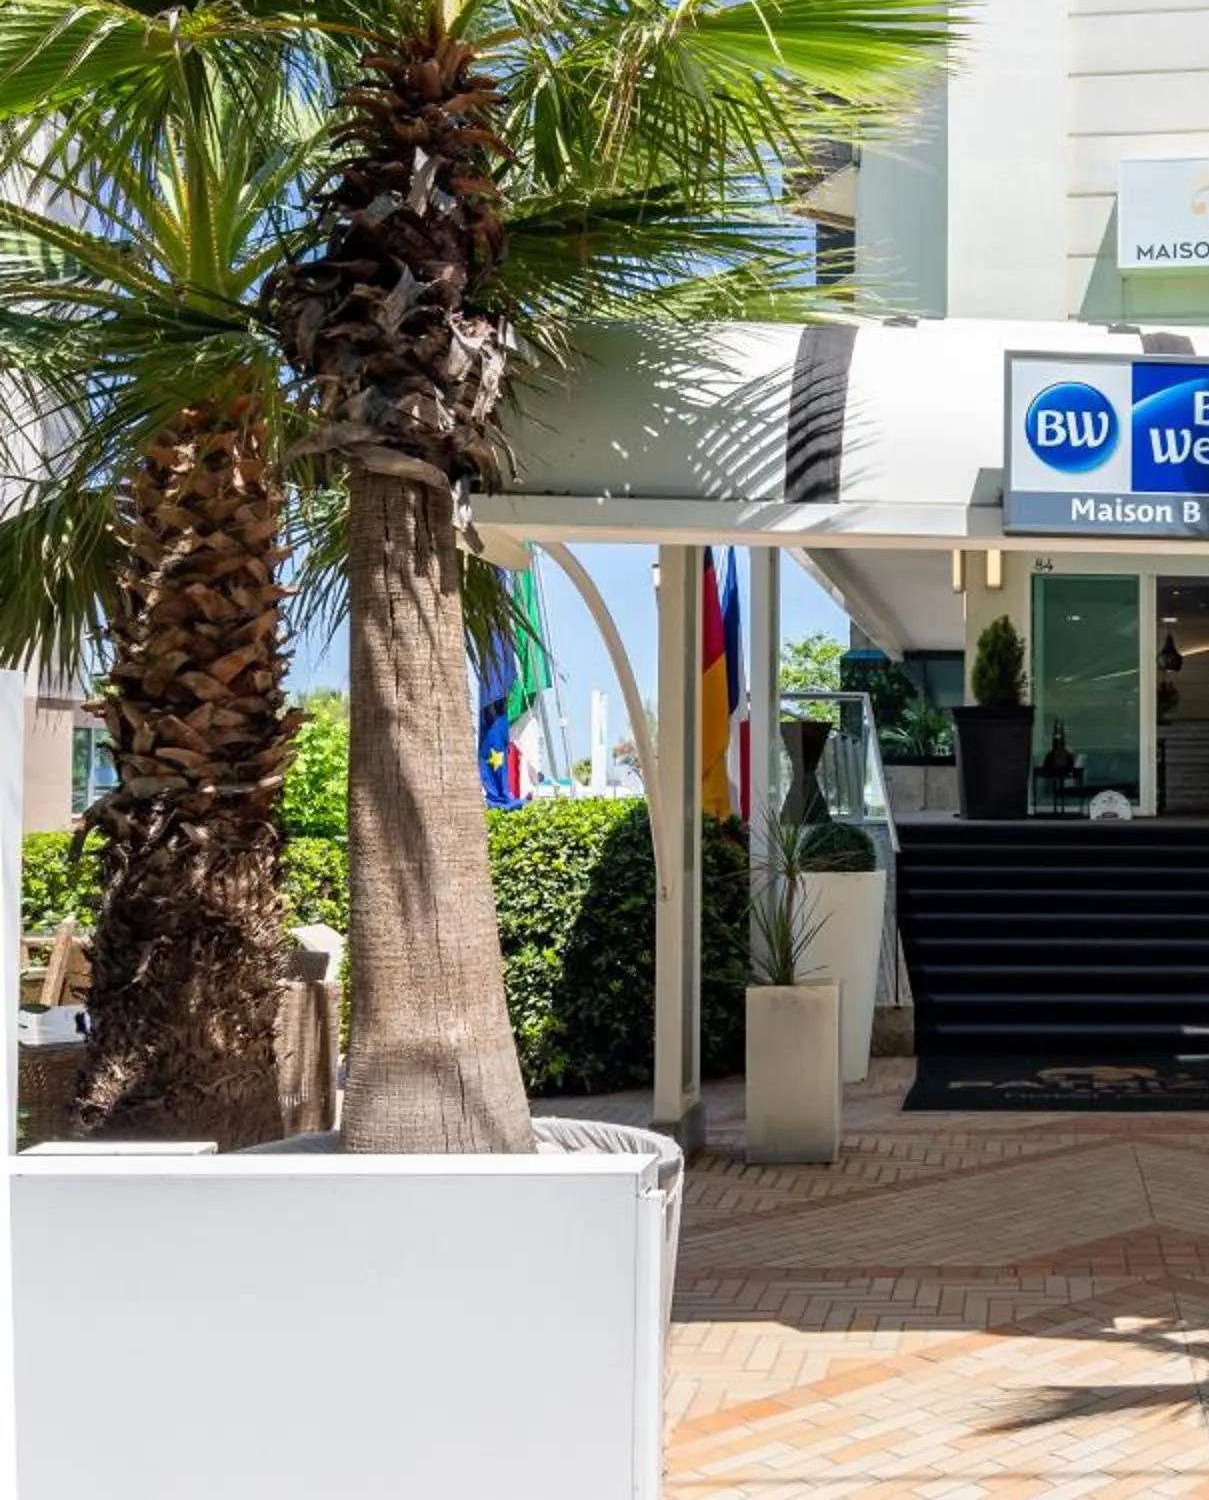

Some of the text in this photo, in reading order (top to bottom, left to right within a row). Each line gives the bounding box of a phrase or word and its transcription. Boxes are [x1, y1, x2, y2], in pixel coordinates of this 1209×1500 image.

[1036, 409, 1109, 448] BW
[1070, 498, 1173, 523] Maison
[1183, 502, 1201, 523] B
